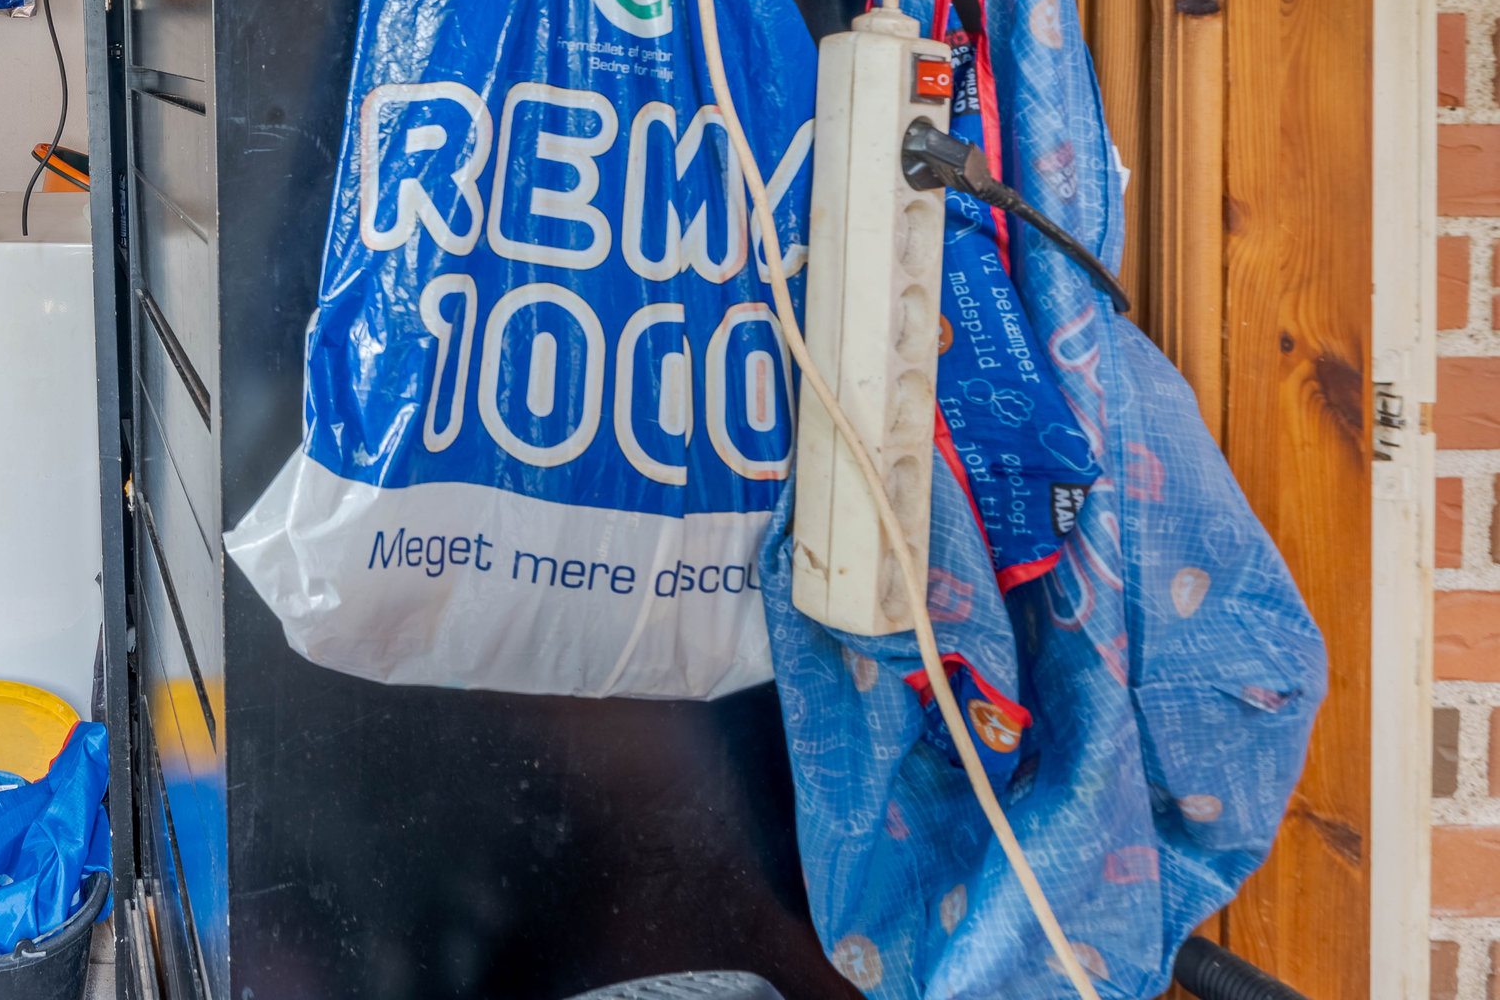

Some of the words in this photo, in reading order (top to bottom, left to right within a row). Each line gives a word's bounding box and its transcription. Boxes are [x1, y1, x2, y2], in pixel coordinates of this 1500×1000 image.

[589, 56, 630, 74] Bedre
[634, 63, 648, 76] for
[948, 271, 1002, 370] madspild
[938, 396, 966, 430] fra
[979, 495, 1003, 531] til
[366, 522, 497, 578] Meget
[512, 548, 637, 599] mere
